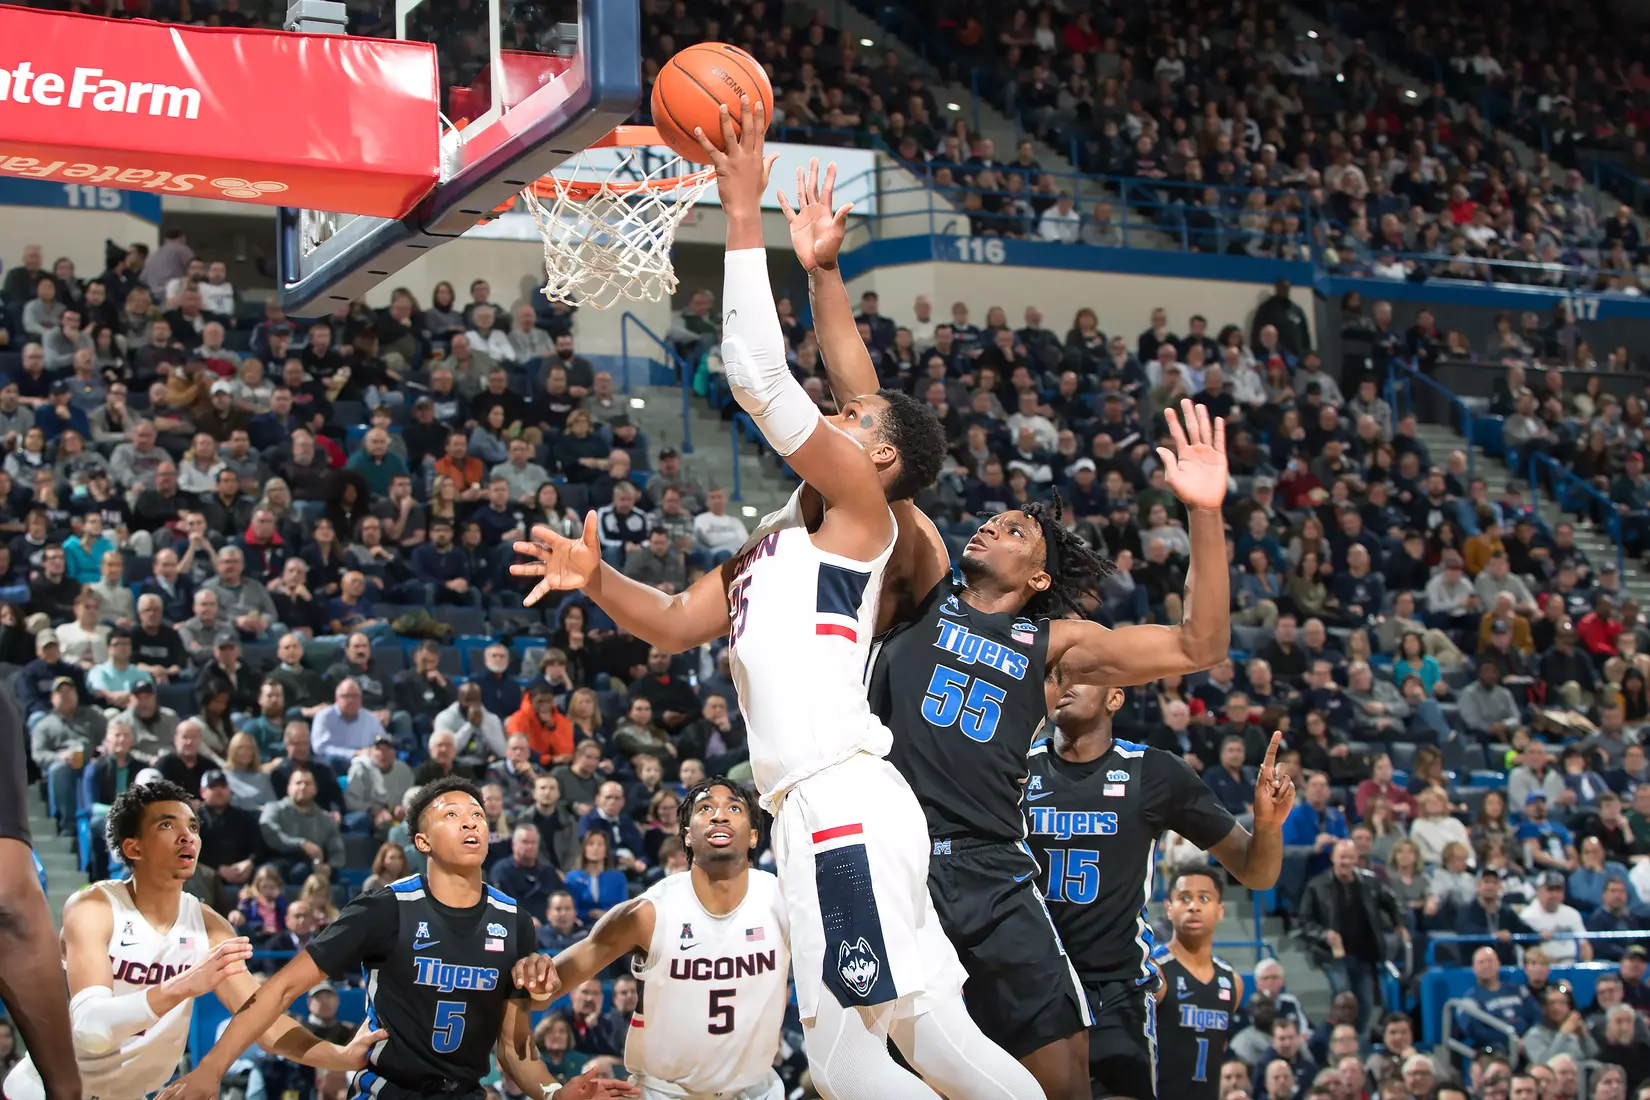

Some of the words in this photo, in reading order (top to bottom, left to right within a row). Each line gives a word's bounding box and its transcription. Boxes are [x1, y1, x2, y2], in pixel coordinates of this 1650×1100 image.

[63, 184, 122, 209] 115
[955, 238, 1006, 264] 116
[1561, 296, 1600, 321] 117
[932, 617, 1030, 681] Tigers
[921, 663, 1008, 743] 55
[1028, 806, 1118, 840] Tigers
[1043, 848, 1100, 905] 15
[108, 954, 193, 986] UCON
[413, 956, 499, 993] Tigers
[669, 949, 776, 981] UCONN
[431, 1000, 467, 1054] 5
[707, 988, 737, 1036] 5
[1178, 1003, 1230, 1032] Tigers
[1191, 1037, 1210, 1082] 1
